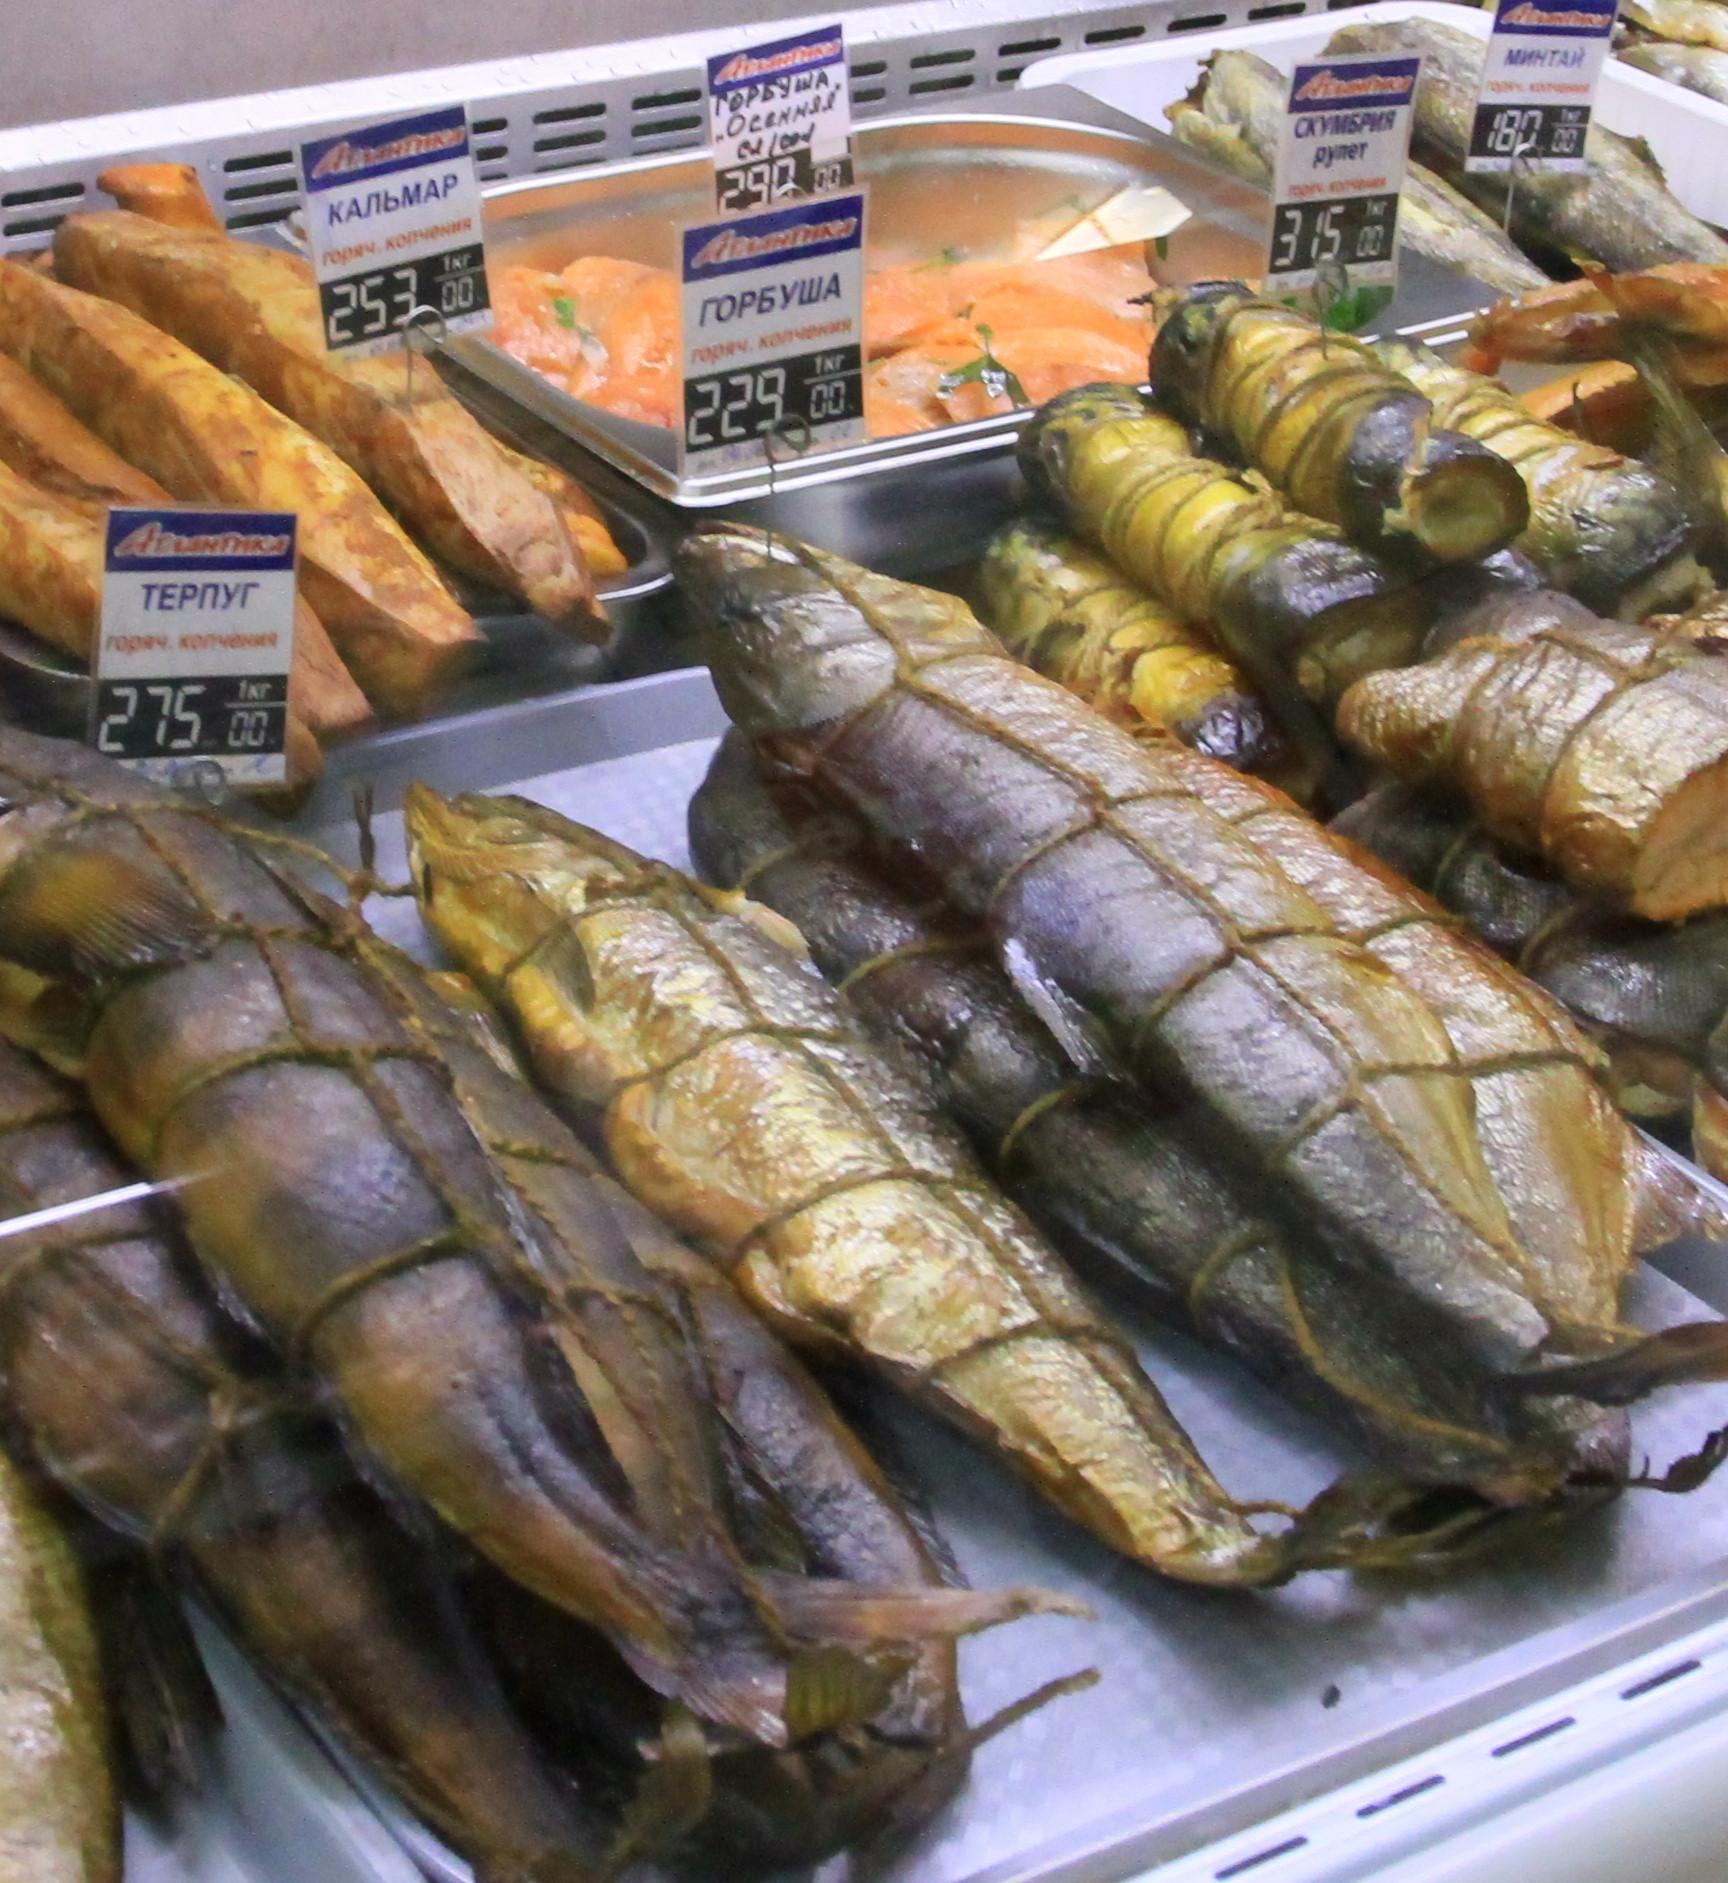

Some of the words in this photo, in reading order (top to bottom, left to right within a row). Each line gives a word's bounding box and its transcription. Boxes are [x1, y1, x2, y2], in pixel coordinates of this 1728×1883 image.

[1504, 46, 1586, 68] МИНТАЙ
[1294, 110, 1397, 138] СКУМБРИЯ
[1487, 109, 1543, 153] 180
[1552, 127, 1578, 153] 00
[1313, 142, 1369, 169] рулет
[328, 173, 459, 227] КАЛЬМАР
[1275, 205, 1346, 266] 315
[1355, 224, 1385, 258] 00
[328, 267, 417, 342] 253
[441, 275, 474, 313] 00
[698, 272, 841, 327] ГОРБУША
[814, 354, 846, 374] 1кг
[687, 367, 786, 445] 229
[809, 380, 846, 419] 00
[141, 582, 261, 612] ТЕРПУГ
[238, 679, 273, 699] 1кг
[97, 684, 208, 753] 275
[227, 710, 269, 747] 00
